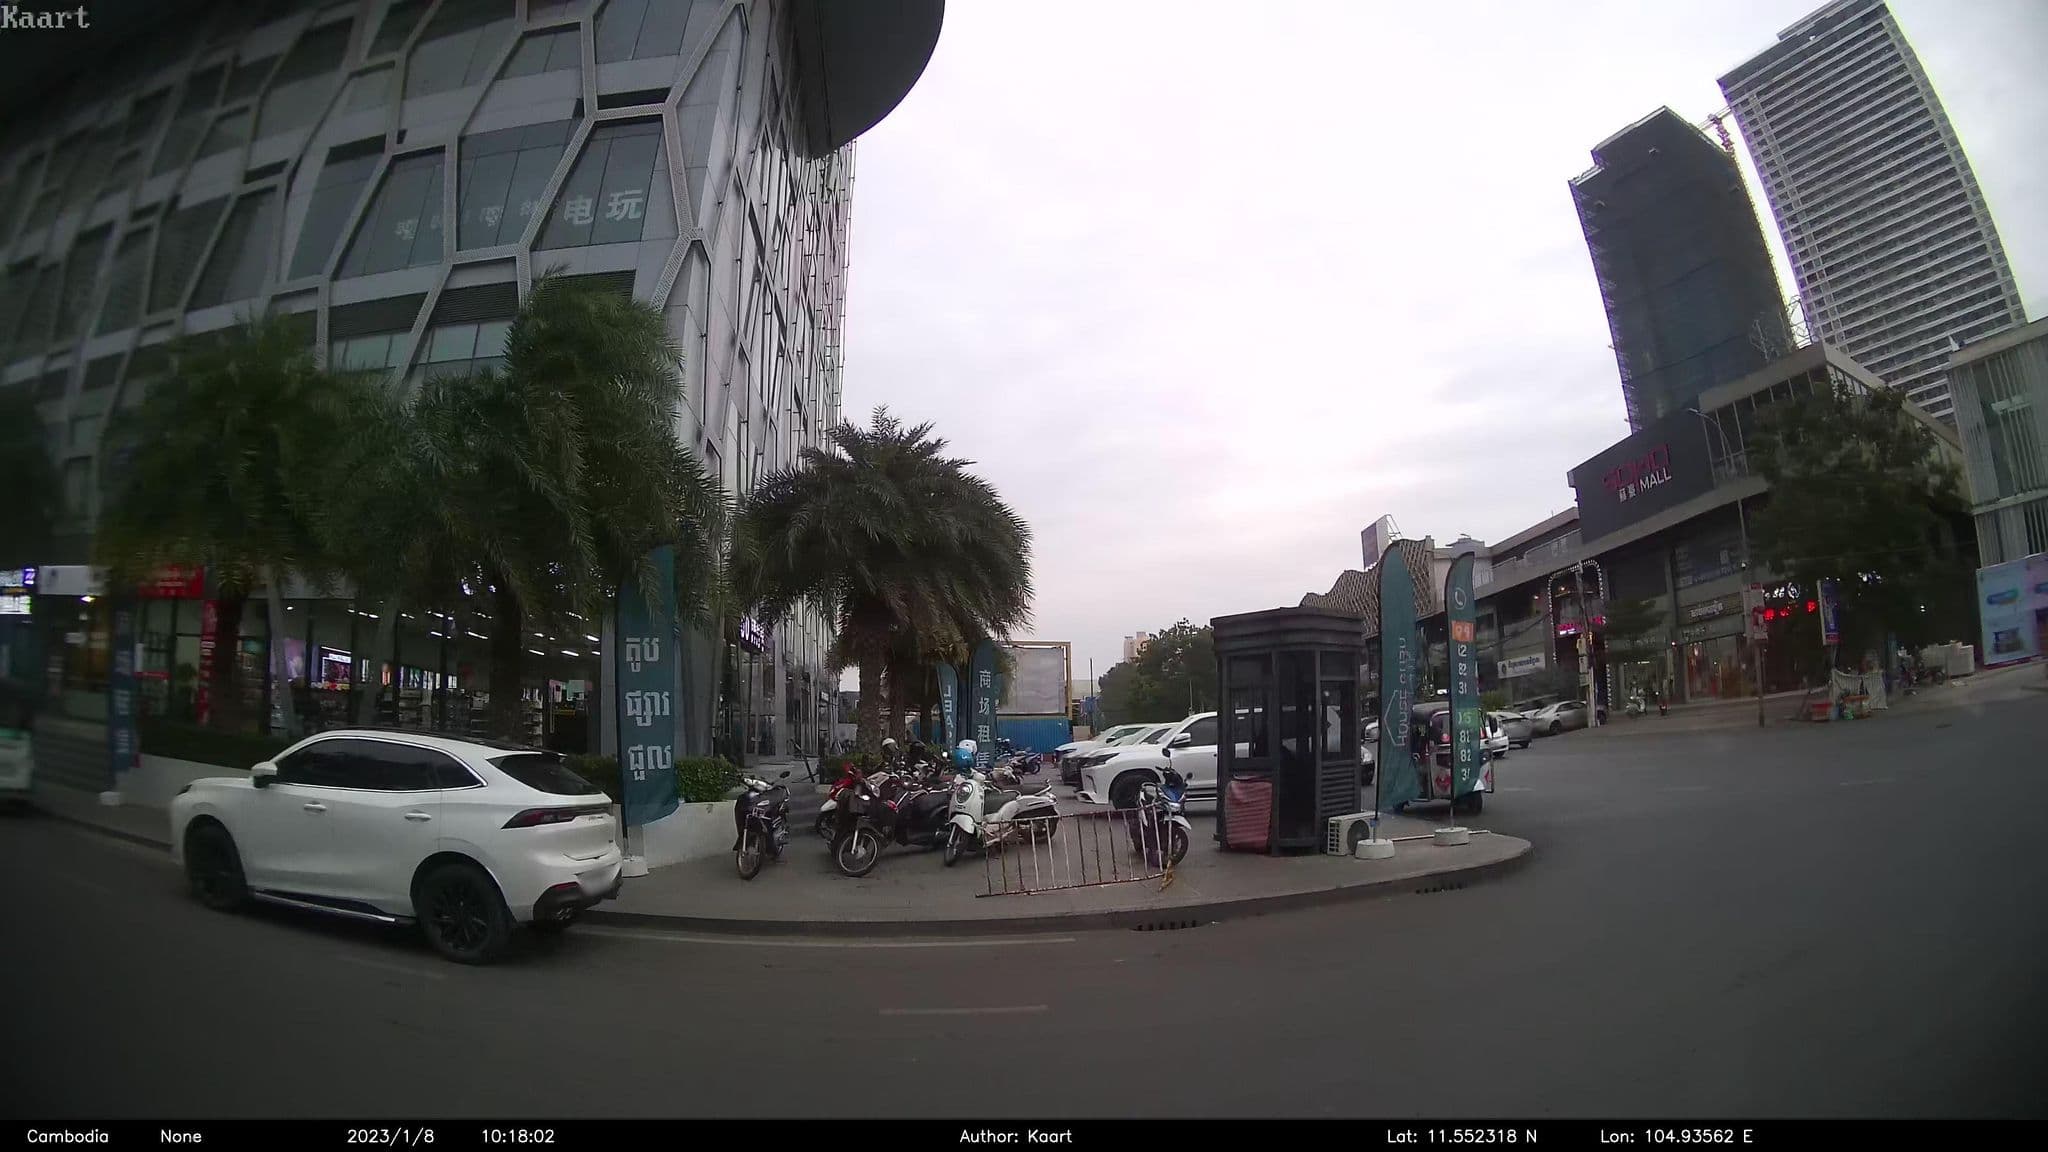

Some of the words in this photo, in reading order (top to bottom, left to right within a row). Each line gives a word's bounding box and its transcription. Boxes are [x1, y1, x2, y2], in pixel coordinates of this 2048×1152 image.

[563, 190, 643, 226] 电玩
[1639, 466, 1672, 494] MALL
[1397, 688, 1408, 746] HOUSE
